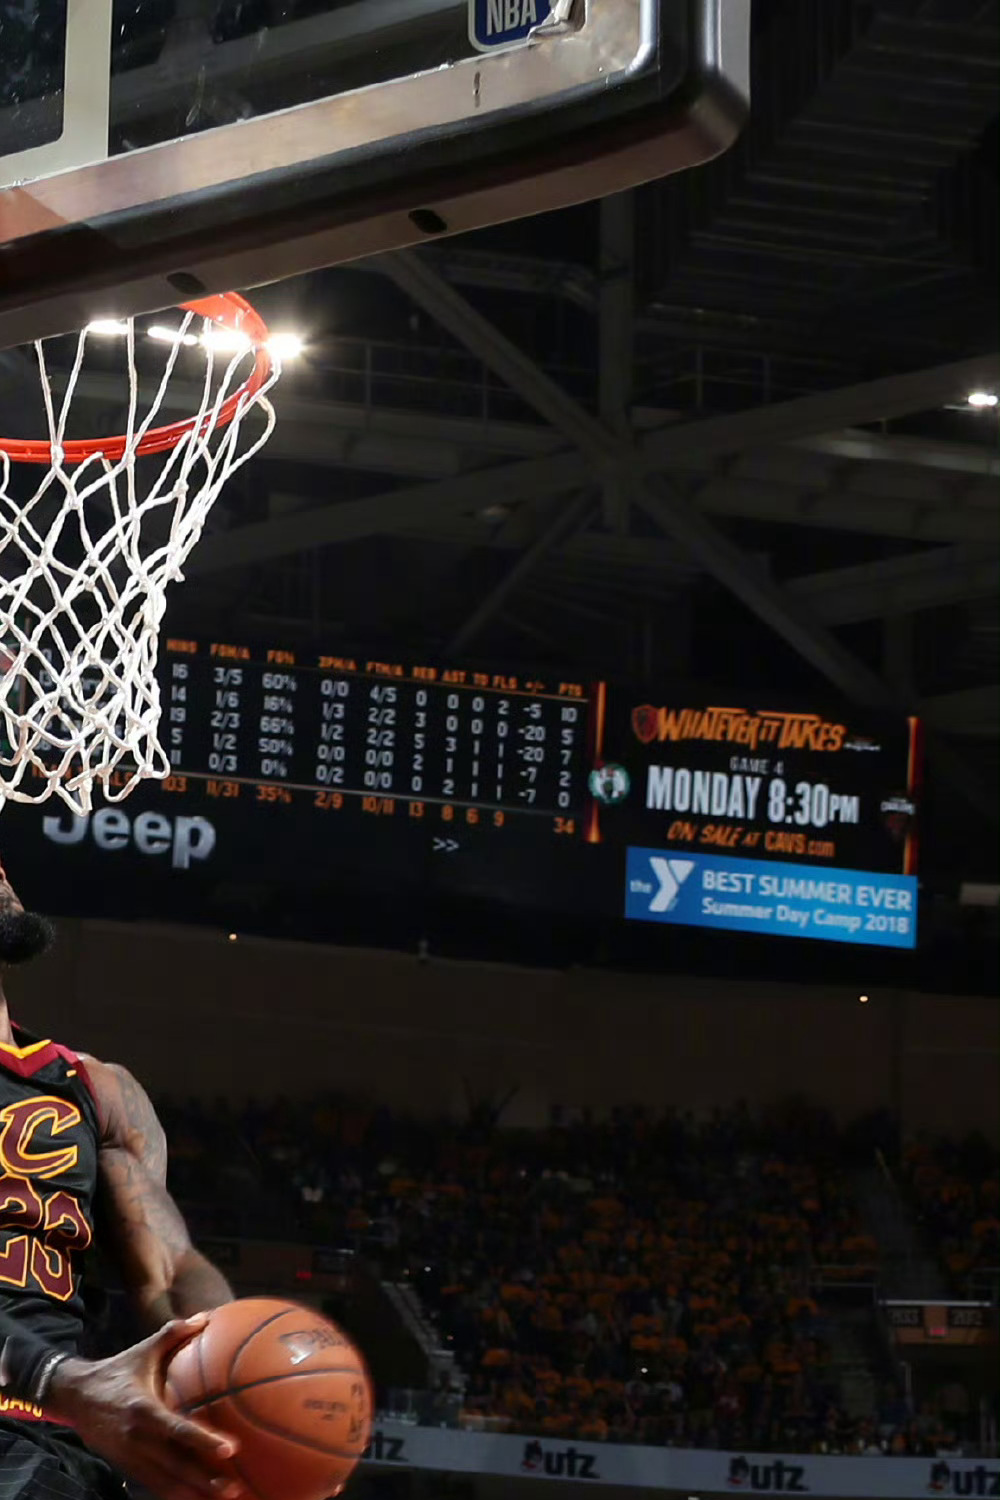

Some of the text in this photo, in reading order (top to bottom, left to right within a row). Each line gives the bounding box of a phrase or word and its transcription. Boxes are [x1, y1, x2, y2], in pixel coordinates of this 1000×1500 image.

[486, 0, 537, 36] NBA
[171, 663, 577, 722] 16 3/5 60% 0/0 4/5 0 0 0 2 -5 10
[171, 685, 573, 745] 14 1/6 16% 1/3 2/2 3 0 0 0 -20 5
[169, 707, 572, 766] 19 2/3 66% 1/2 2/2 5 3 1 1 -20 7
[658, 706, 760, 750] WHATEVER
[776, 711, 847, 751] TAKES
[170, 750, 569, 808] 11 0/3 0% 0/2 0/0 0 2 1 1 -7 0
[171, 728, 571, 788] 5 1/2 50% 0/0 0/0 2 1 1 1 -7 2
[729, 756, 770, 775] GAME
[162, 777, 575, 834] 103 11/31 35% 2/9 10/11 13 8 6 9 34
[646, 764, 761, 820] MONDAY
[43, 806, 216, 868] Jeep
[666, 820, 696, 842] ON
[699, 823, 743, 848] SALE
[741, 831, 762, 848] AT
[630, 880, 652, 893] the
[702, 870, 912, 912] BEST SUMMER EVER
[702, 897, 910, 935] Summer Day Camp 2018
[0, 1095, 81, 1179] C
